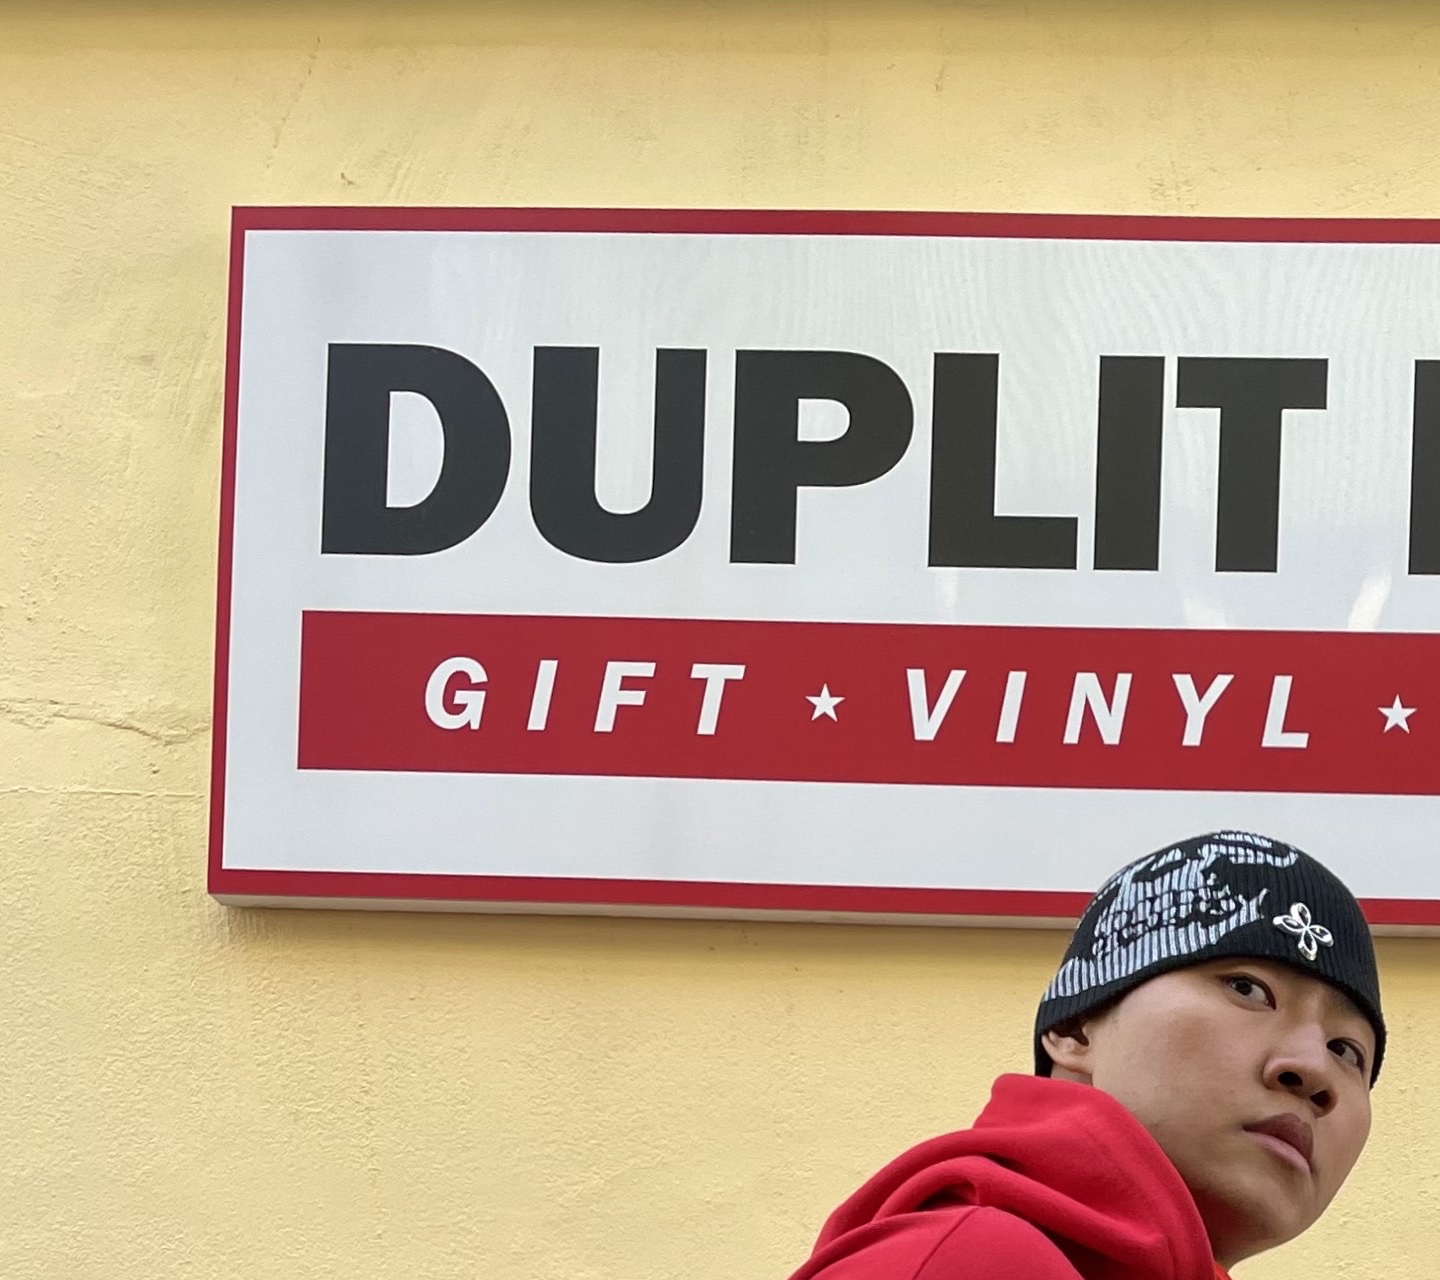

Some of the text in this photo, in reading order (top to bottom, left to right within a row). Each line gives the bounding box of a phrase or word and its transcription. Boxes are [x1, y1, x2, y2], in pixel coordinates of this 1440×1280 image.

[320, 343, 1329, 573] DUPLIT
[424, 656, 746, 735] GIFT
[906, 668, 1309, 749] VINYL
